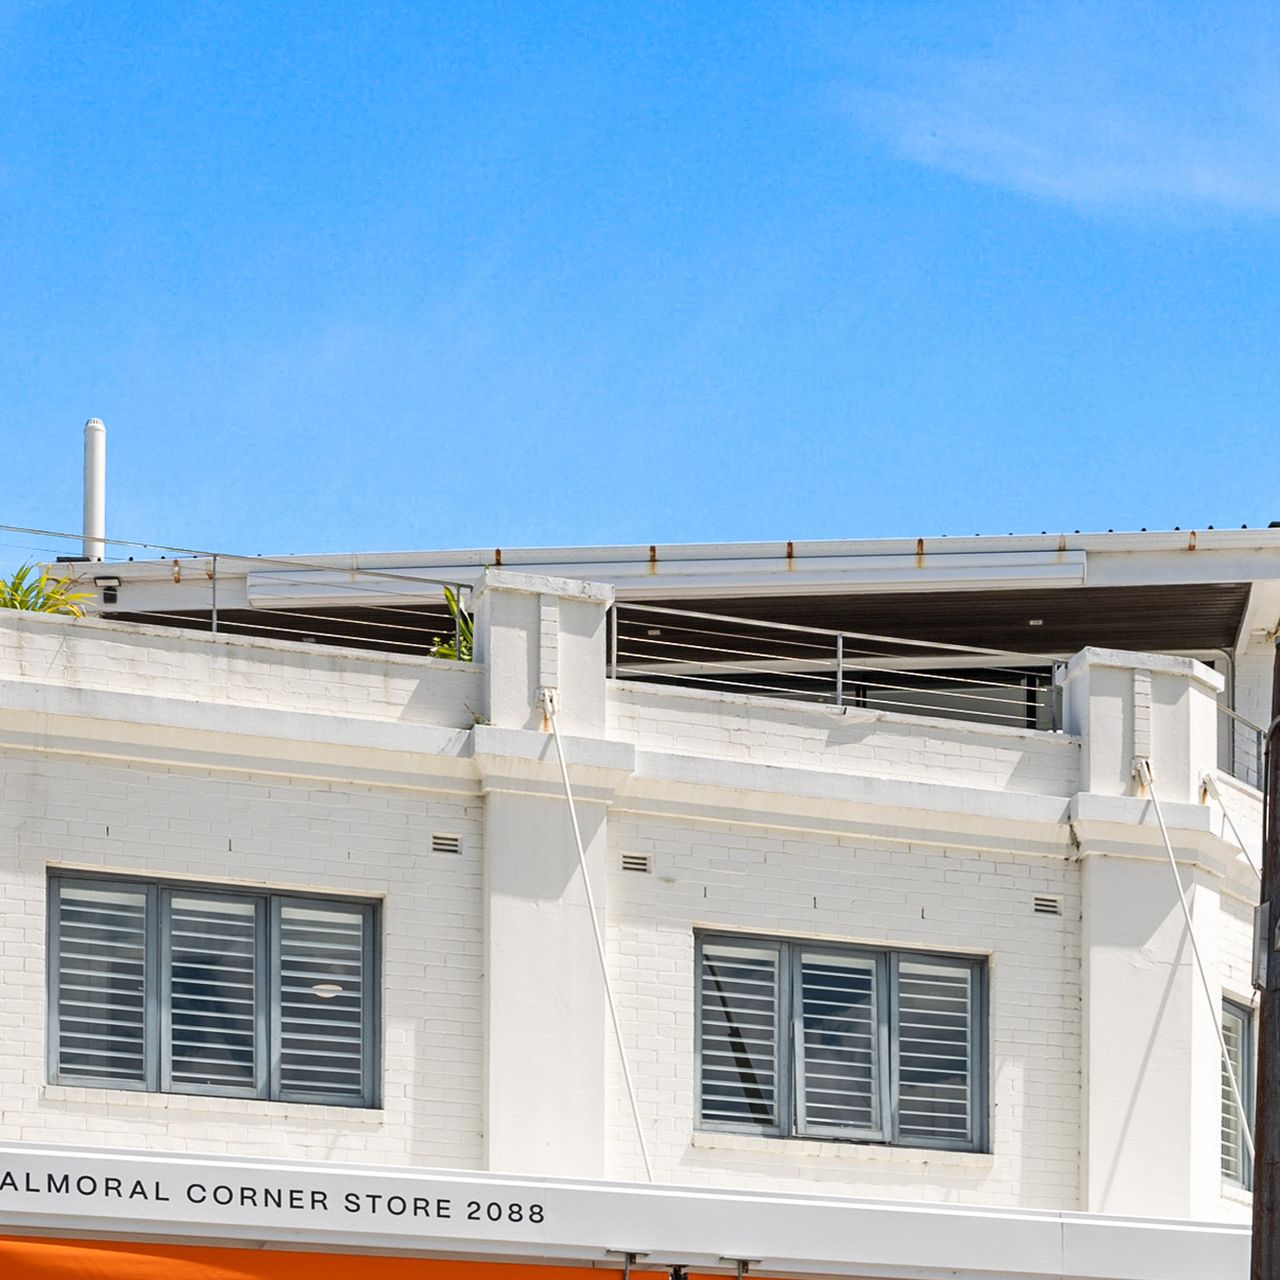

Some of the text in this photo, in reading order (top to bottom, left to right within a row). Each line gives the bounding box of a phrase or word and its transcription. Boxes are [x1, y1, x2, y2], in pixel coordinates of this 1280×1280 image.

[186, 1183, 328, 1211] CORNER
[344, 1192, 451, 1219] STORE
[467, 1200, 545, 1224] 2088
